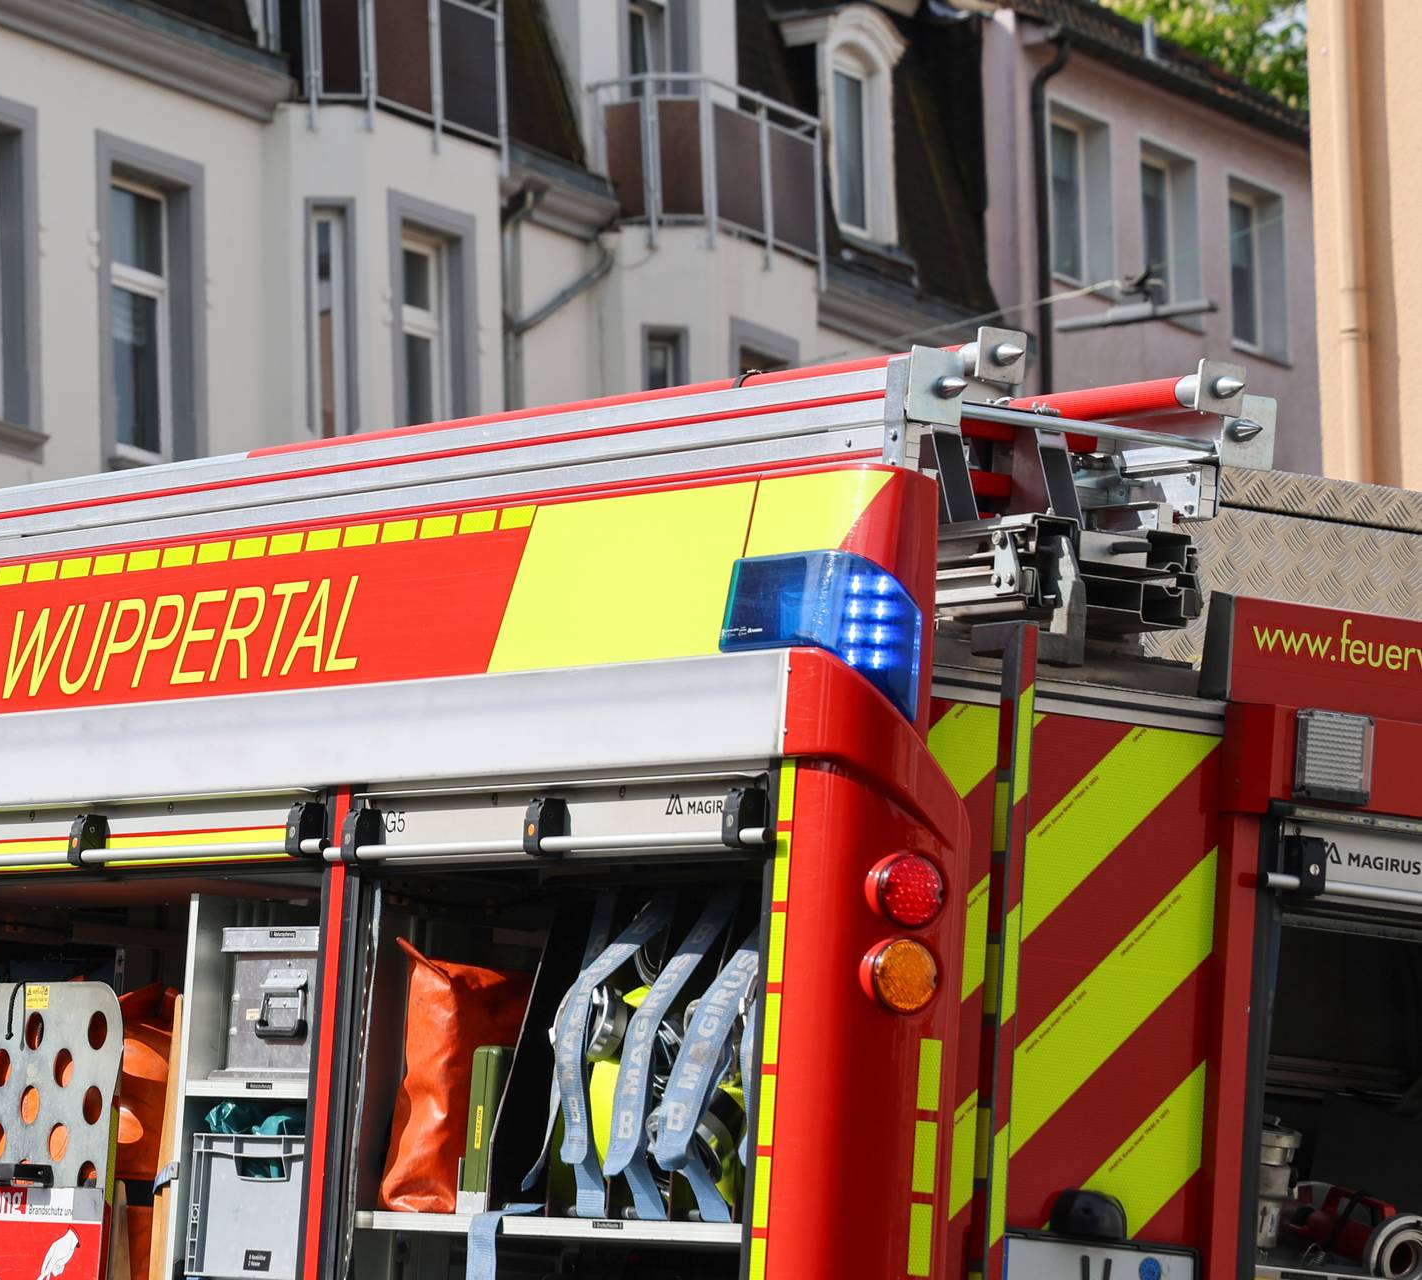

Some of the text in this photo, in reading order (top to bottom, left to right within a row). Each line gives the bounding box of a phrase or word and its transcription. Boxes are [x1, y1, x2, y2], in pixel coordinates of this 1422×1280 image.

[2, 575, 359, 699] WUPPERTAL
[1252, 618, 1422, 671] www.feuer
[385, 810, 406, 833] G5
[1347, 851, 1421, 876] MAGIRUS
[623, 953, 691, 1096] MAGIRUS
[666, 953, 759, 1133] B MAGIRUS
[617, 1109, 634, 1140] B
[28, 1205, 63, 1217] Brandschutz
